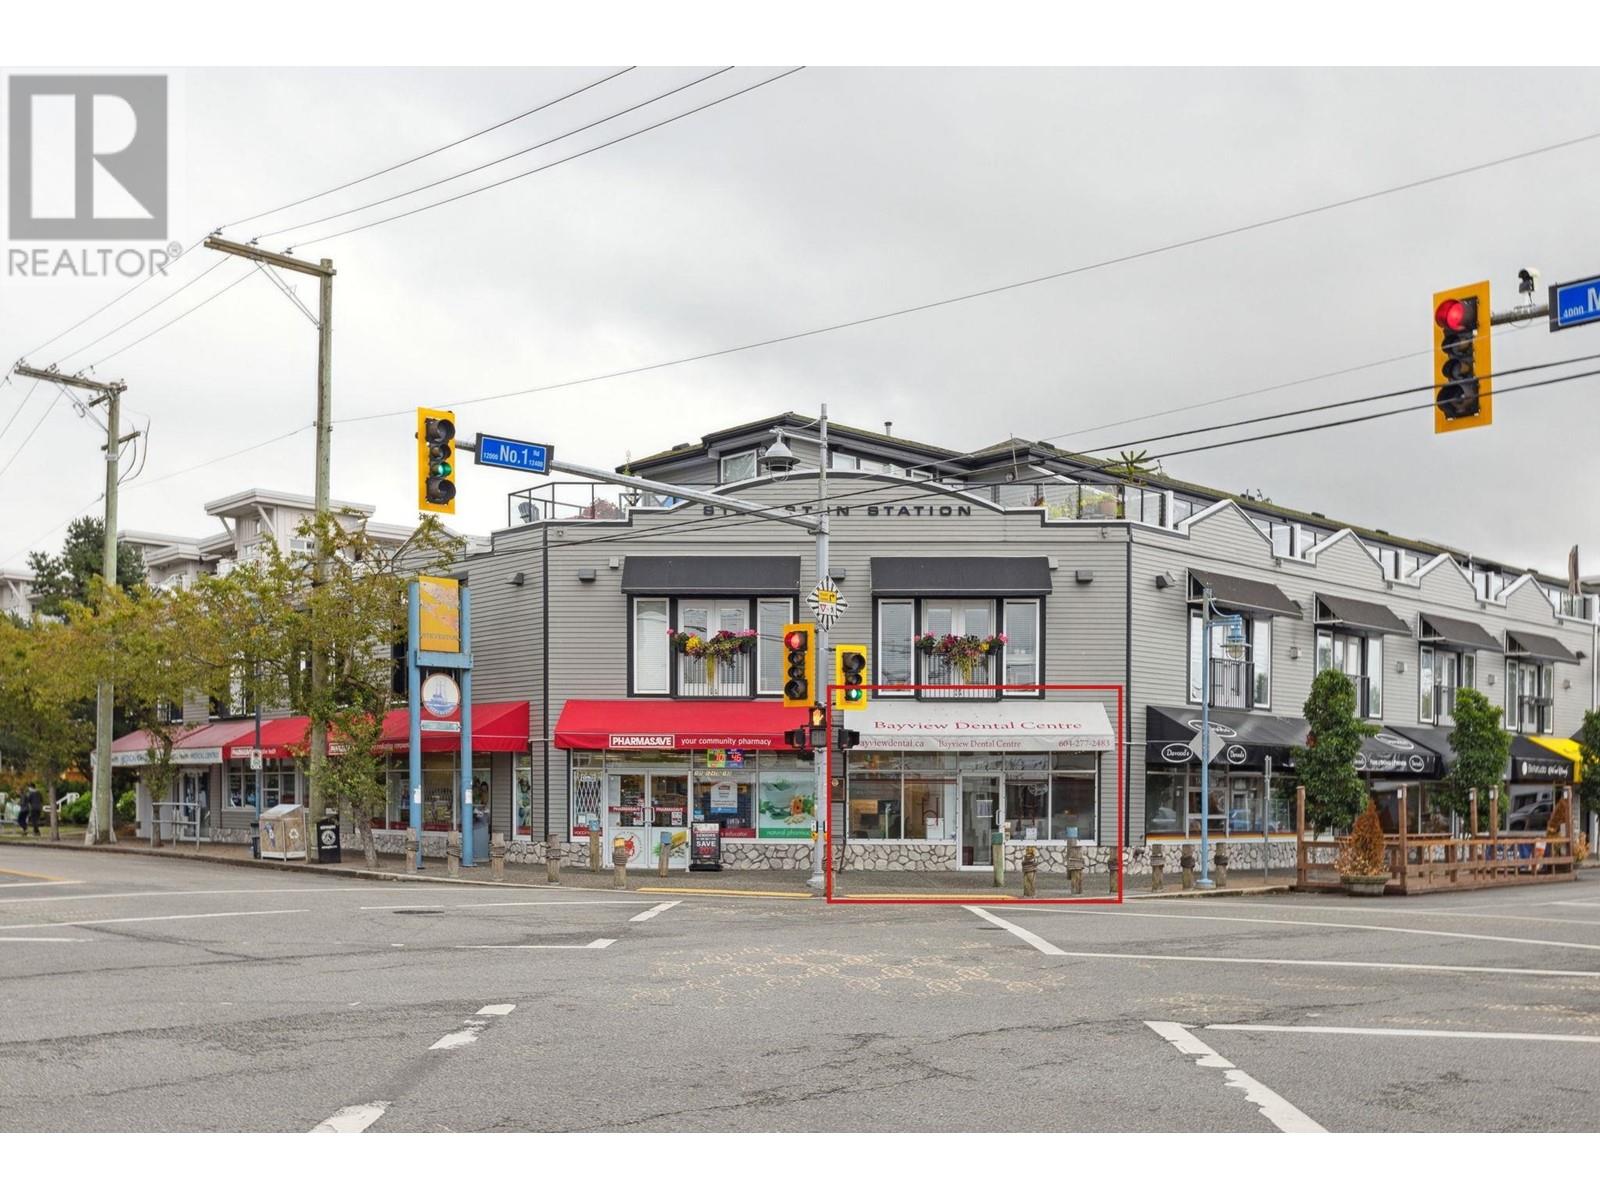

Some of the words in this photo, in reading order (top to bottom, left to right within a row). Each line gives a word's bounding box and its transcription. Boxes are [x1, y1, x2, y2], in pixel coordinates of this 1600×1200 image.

[1563, 305, 1584, 318] 4000
[483, 452, 498, 460] 12000
[500, 445, 528, 464] No.1
[867, 506, 971, 517] STATION
[874, 721, 949, 731] Bayview
[955, 721, 1014, 730] Dental
[1020, 721, 1082, 730] Centre
[612, 736, 672, 745] PHARMASAVE
[738, 738, 772, 746] pharmacy
[860, 739, 925, 748] ayviewdental.ca
[938, 740, 968, 748] Bayview
[996, 740, 1022, 748] Centre
